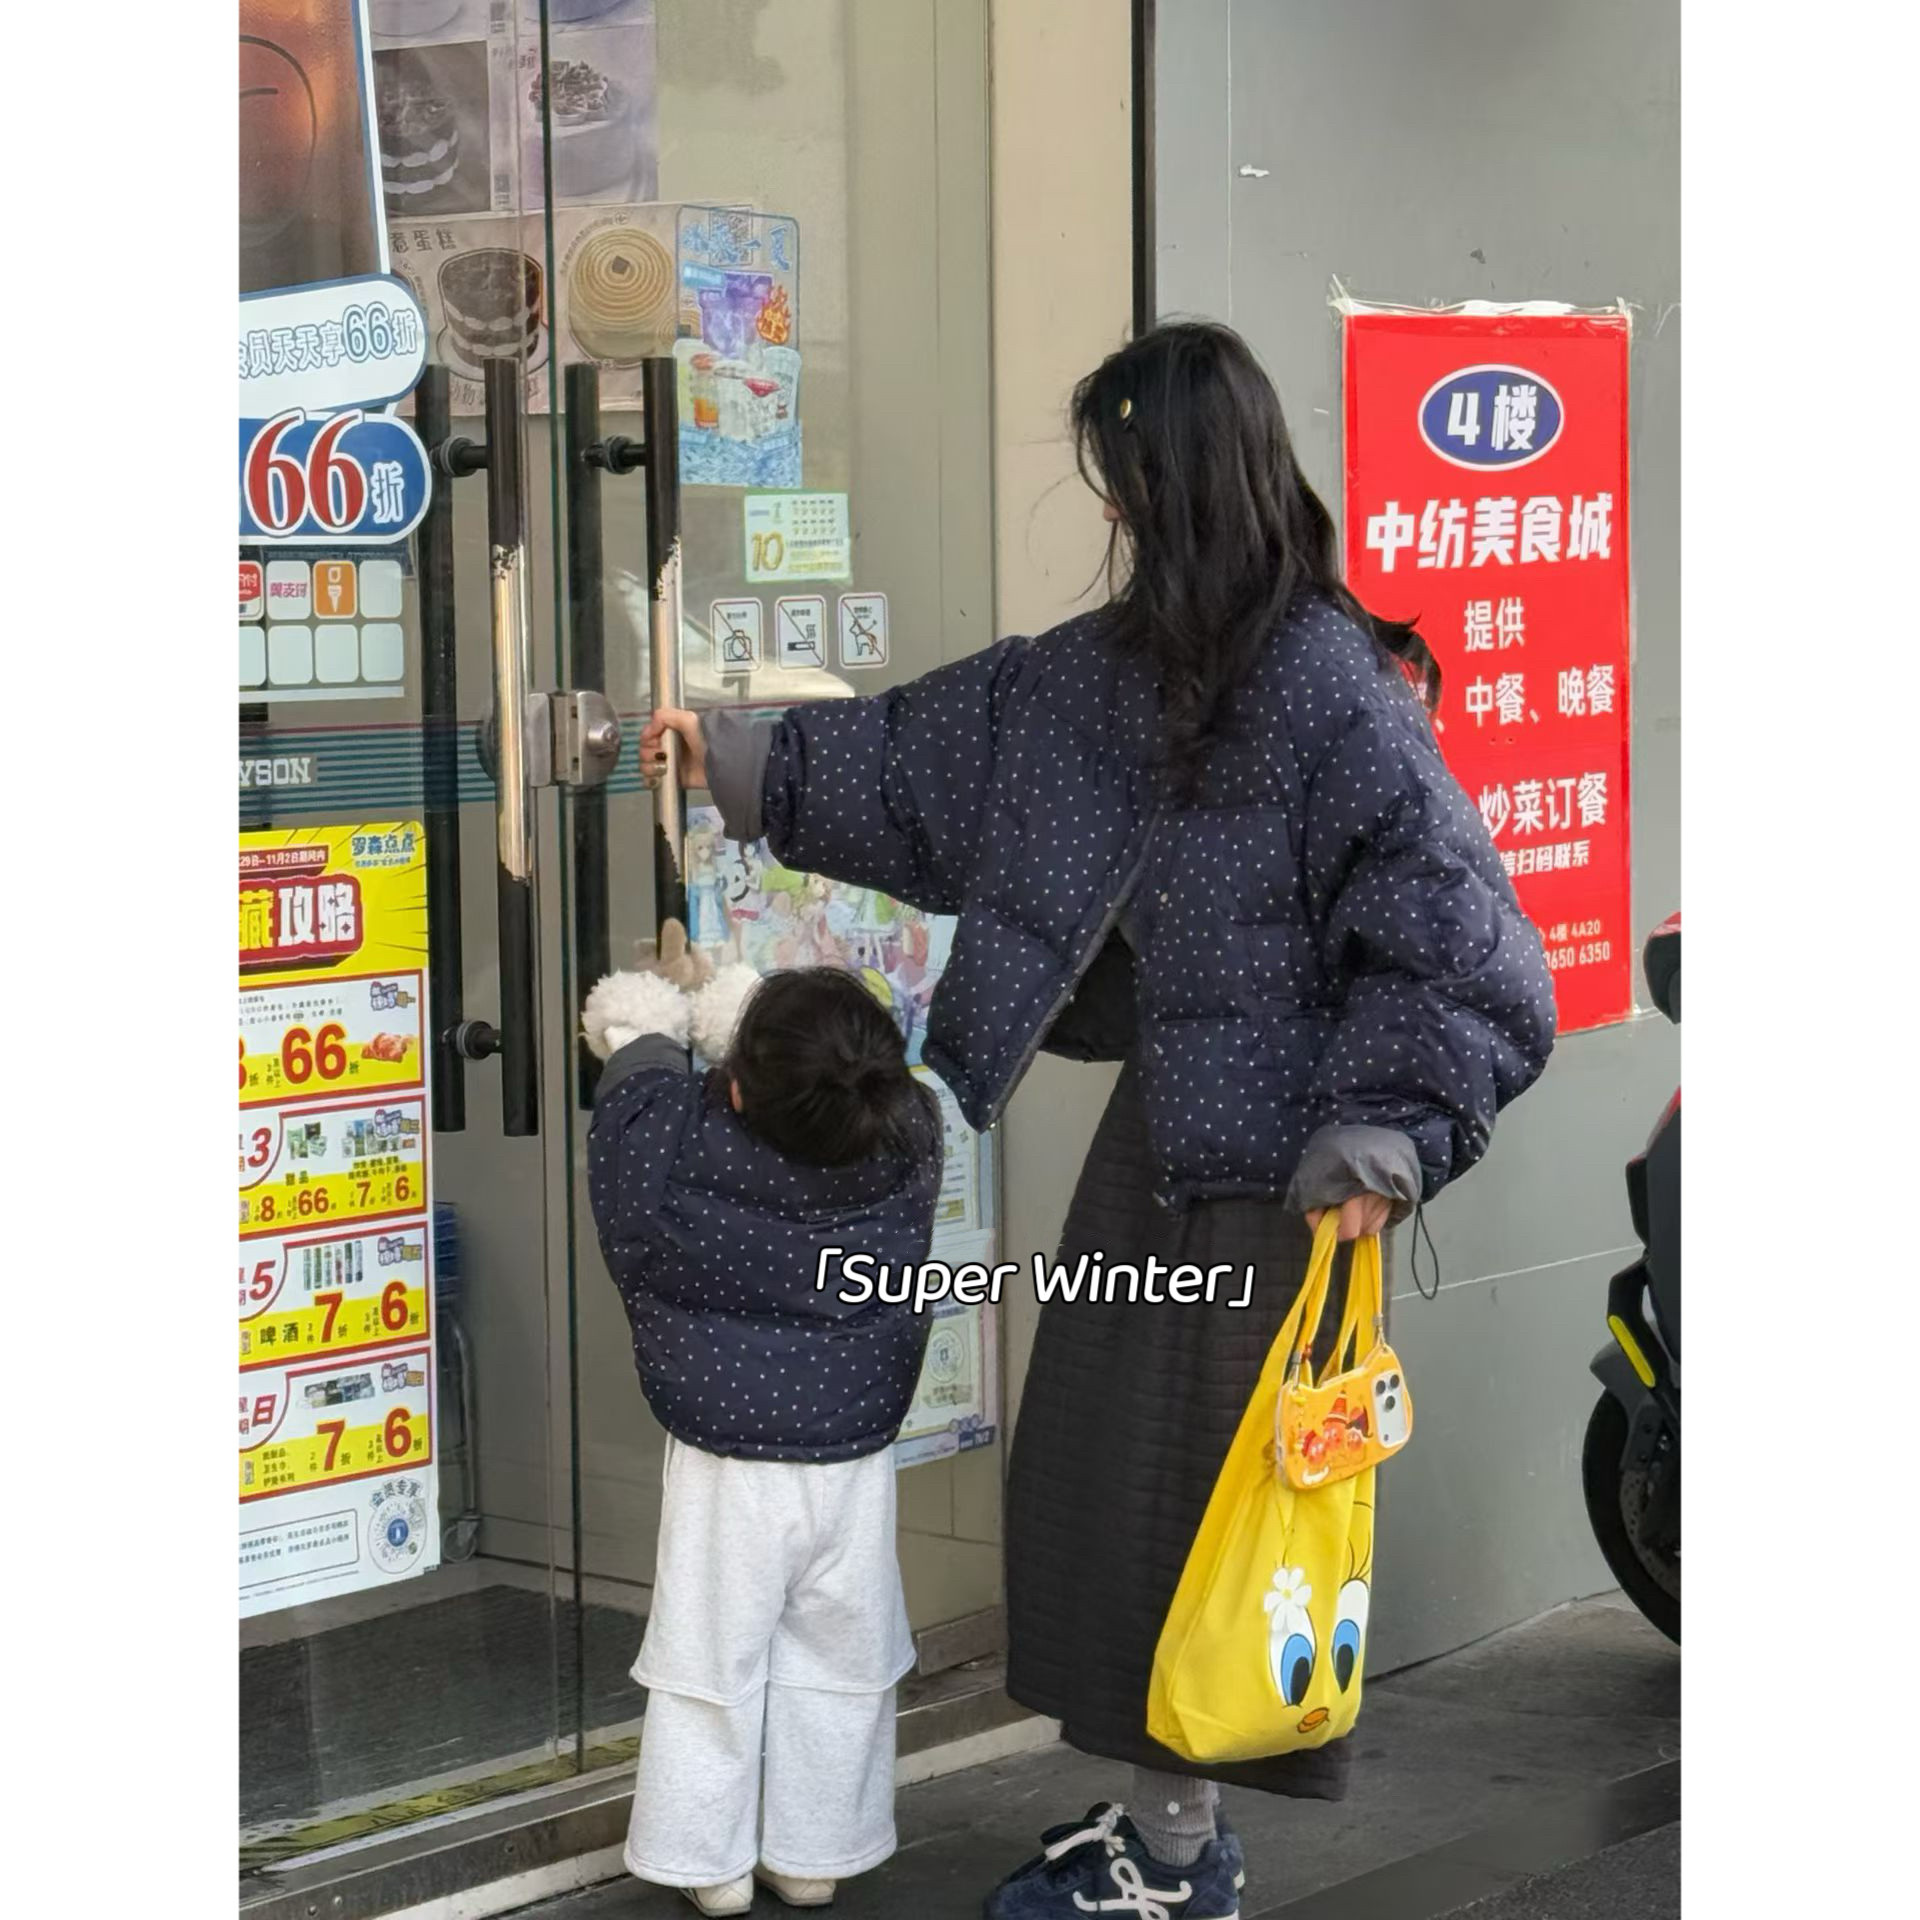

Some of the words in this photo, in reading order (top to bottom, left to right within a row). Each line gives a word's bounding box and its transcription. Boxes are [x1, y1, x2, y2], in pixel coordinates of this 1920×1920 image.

[1447, 384, 1538, 451] 4楼
[752, 531, 784, 572] 10
[1365, 492, 1614, 573] 中纺美食城
[1463, 597, 1526, 652] 提供
[1479, 772, 1608, 839] 炒菜订餐
[1571, 918, 1601, 938] 4A20
[1579, 940, 1610, 966] 6350
